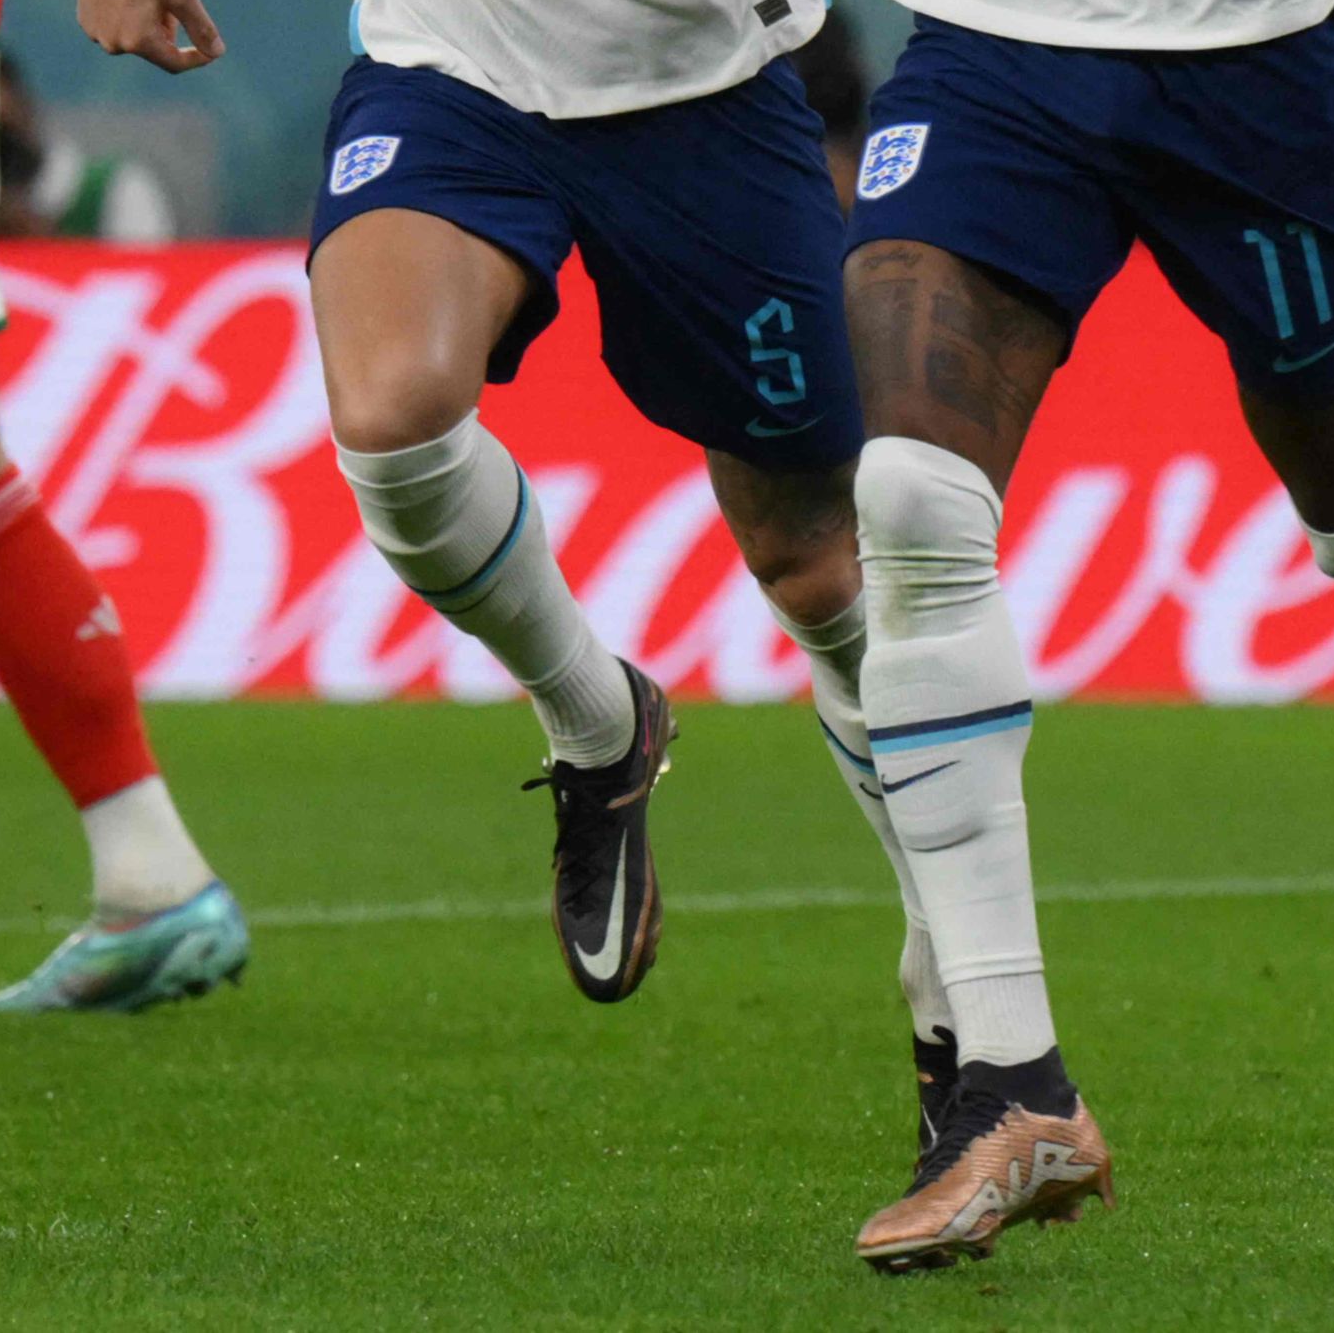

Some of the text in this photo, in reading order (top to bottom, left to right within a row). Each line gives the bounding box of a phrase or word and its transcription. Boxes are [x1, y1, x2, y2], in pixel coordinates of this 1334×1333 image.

[1243, 223, 1332, 339] 11
[745, 298, 806, 405] 5
[937, 1140, 1099, 1239] AIR
